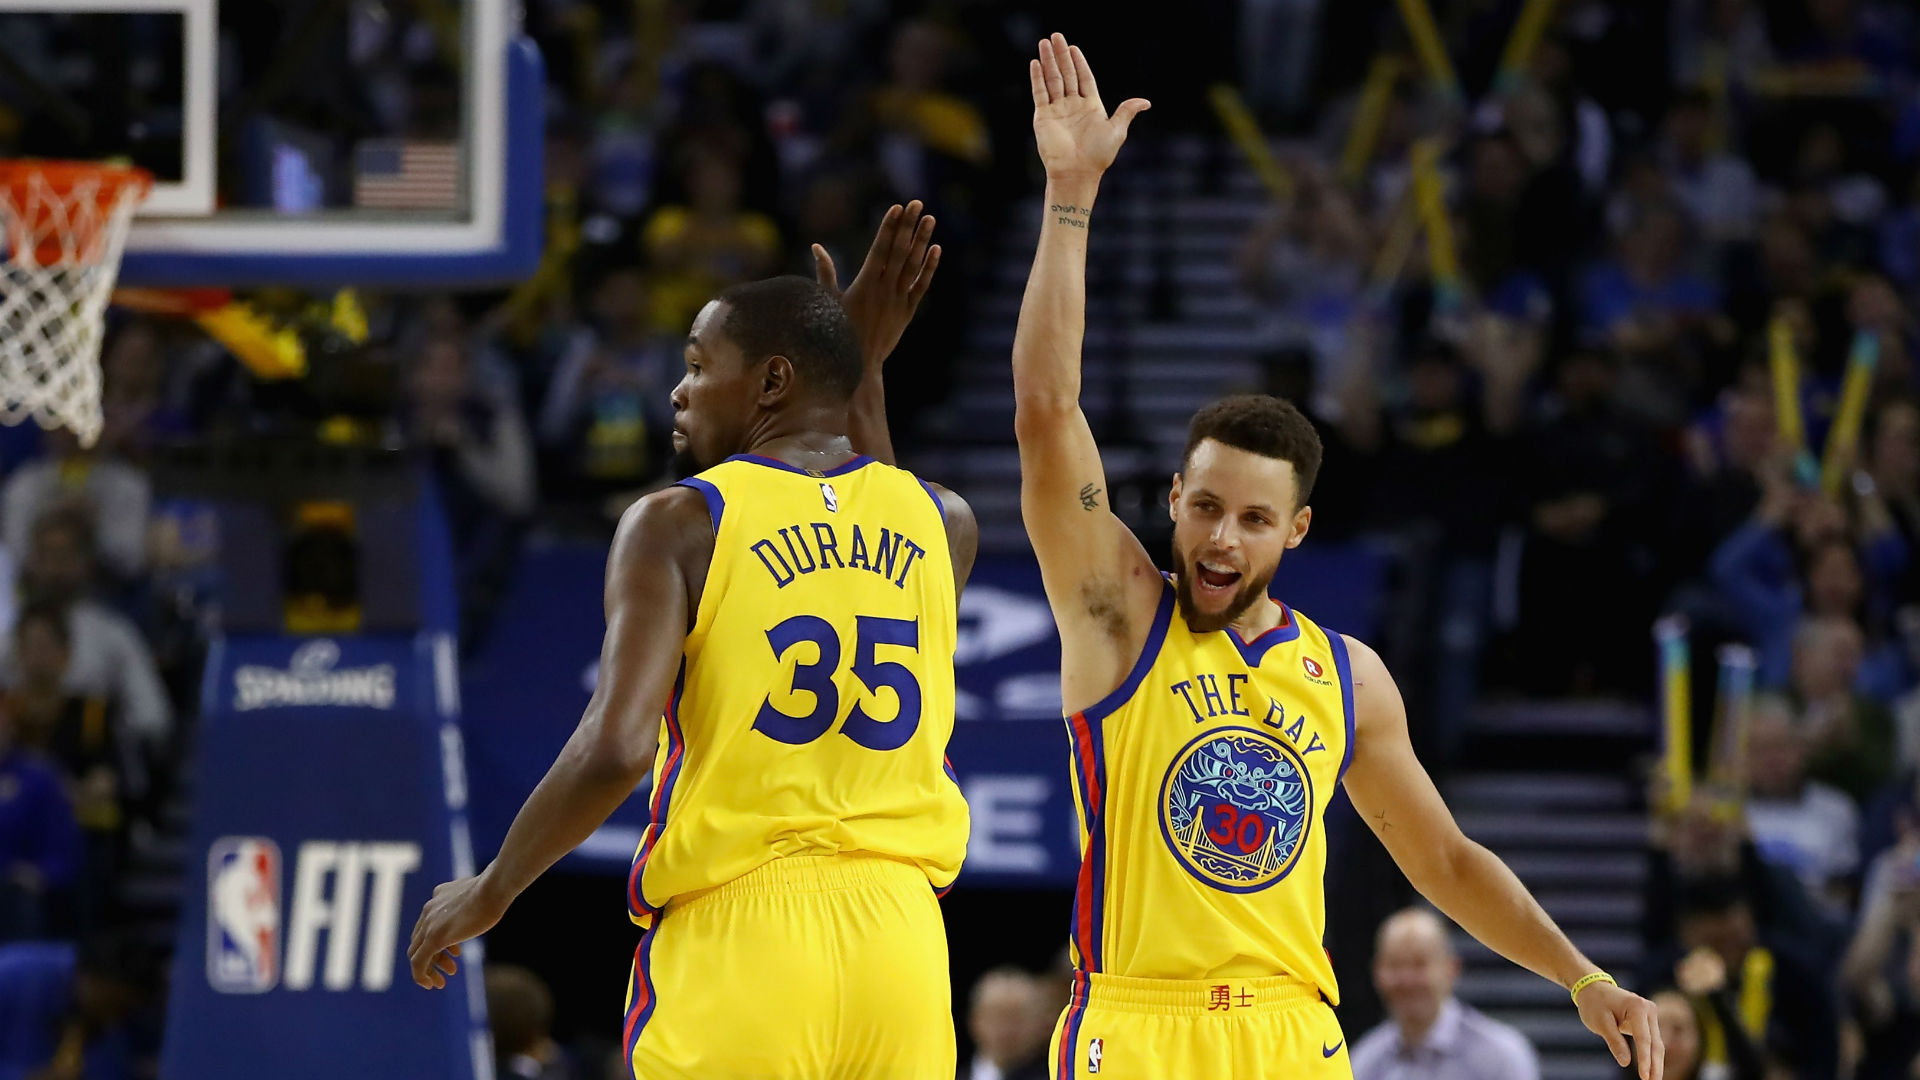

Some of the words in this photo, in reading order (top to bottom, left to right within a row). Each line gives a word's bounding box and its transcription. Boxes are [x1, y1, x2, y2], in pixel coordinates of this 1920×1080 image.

[750, 522, 926, 589] DURANT
[750, 615, 922, 751] 35
[1170, 673, 1250, 724] THE
[1262, 696, 1326, 756] BAY
[1208, 803, 1264, 854] 30
[282, 839, 423, 993] FIT
[1207, 984, 1255, 1012] 勇士
